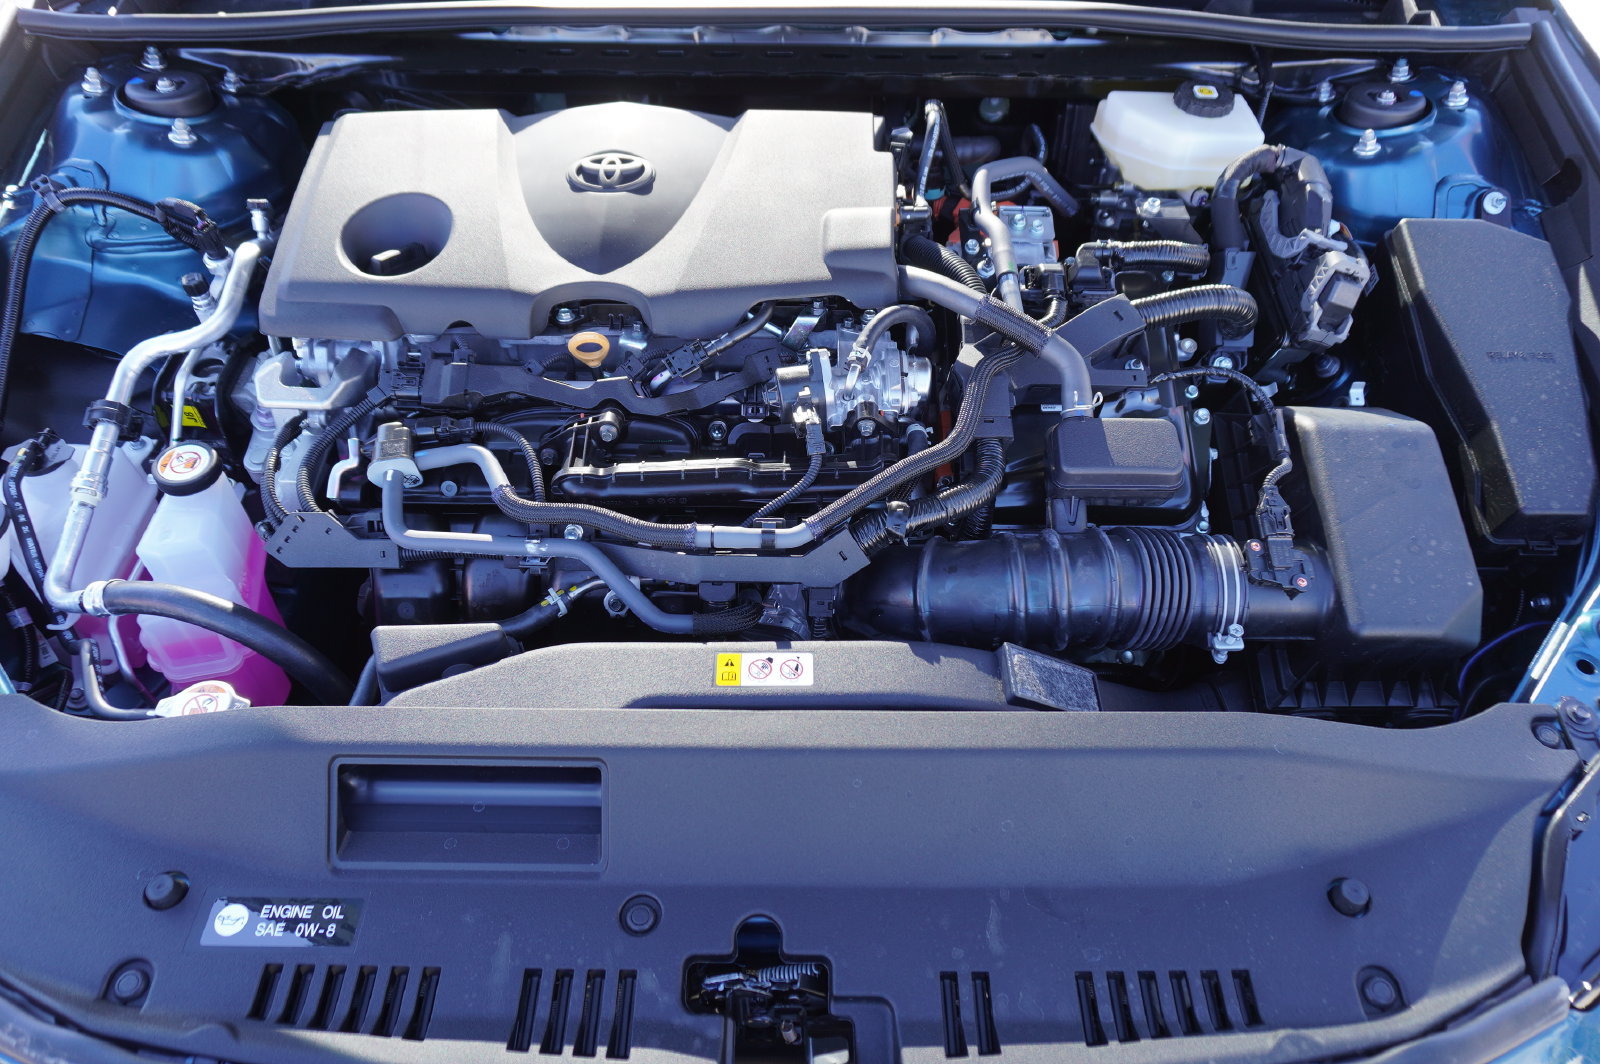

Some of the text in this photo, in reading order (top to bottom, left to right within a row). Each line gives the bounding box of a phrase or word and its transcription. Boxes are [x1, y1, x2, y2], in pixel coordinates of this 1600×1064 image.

[260, 905, 344, 920] ENGINE OIL
[255, 921, 336, 938] SAE 0W-8
